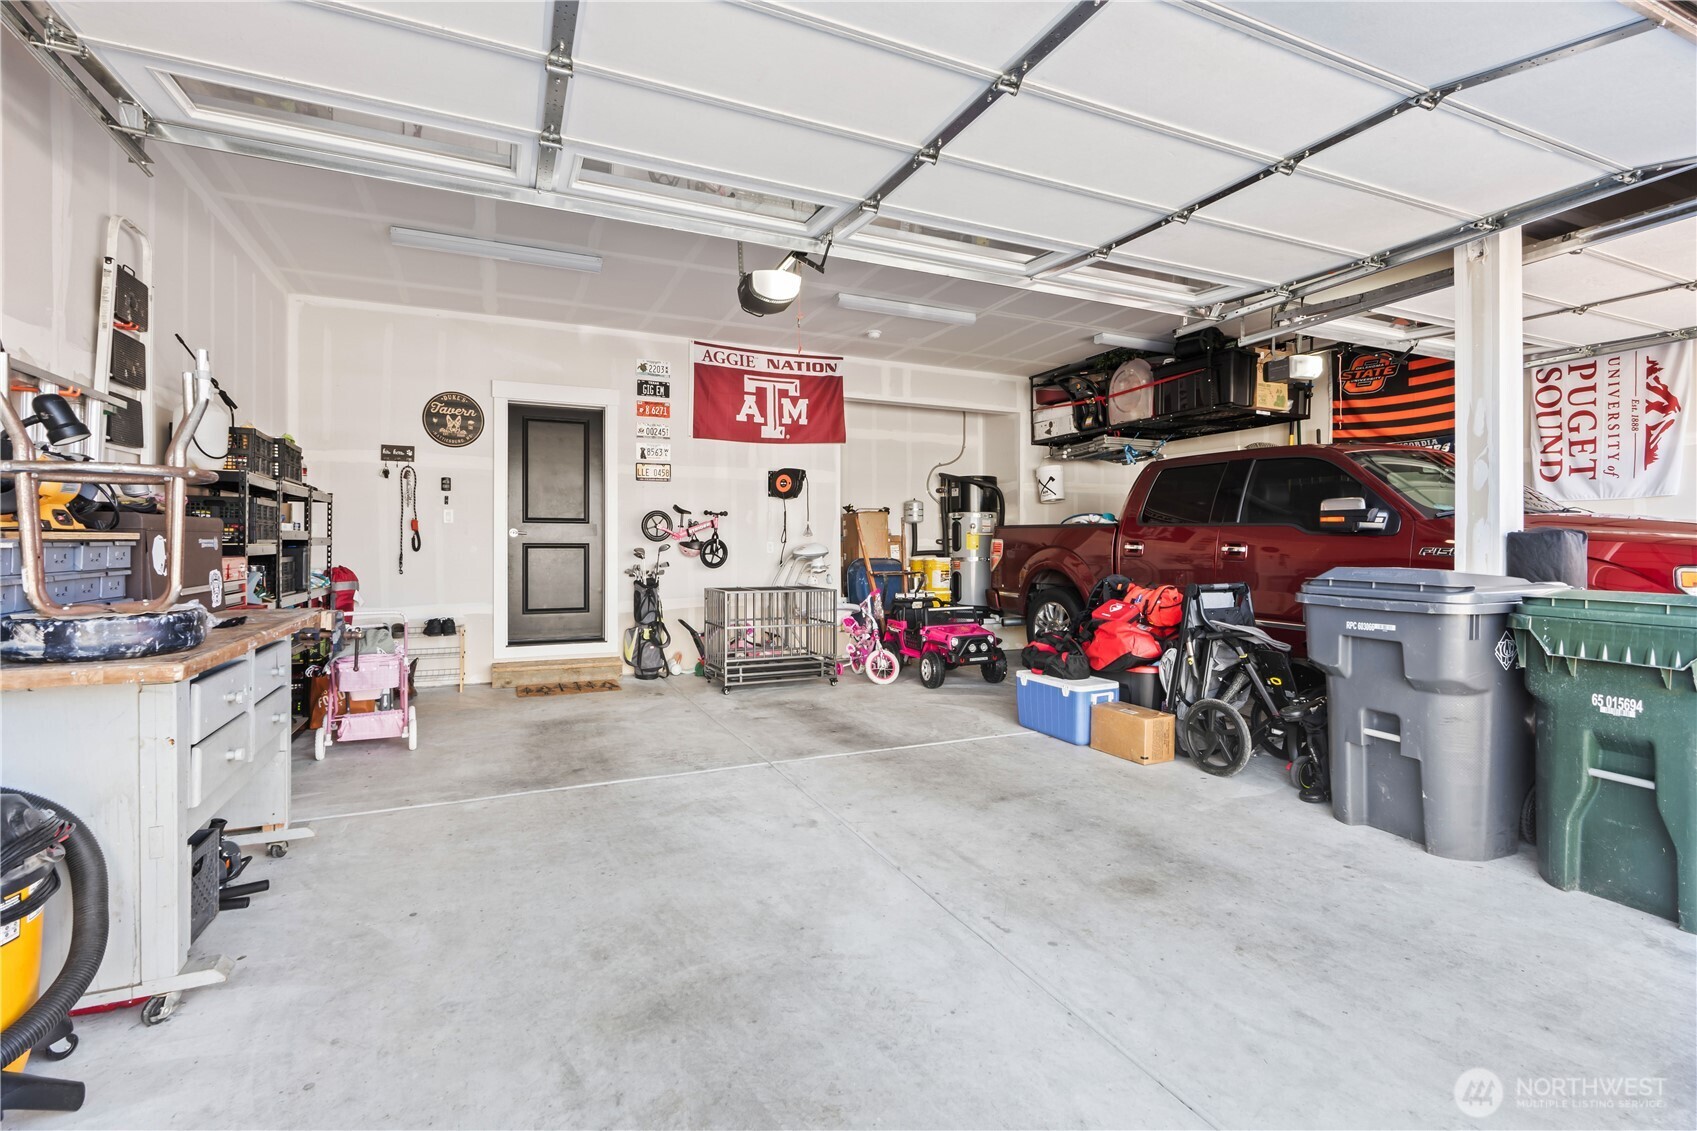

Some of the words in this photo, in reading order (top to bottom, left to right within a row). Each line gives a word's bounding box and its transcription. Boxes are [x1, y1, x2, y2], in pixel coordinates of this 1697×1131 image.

[649, 364, 664, 374] 2203
[702, 350, 755, 368] AGGIE
[767, 358, 837, 373] NATION
[1341, 365, 1396, 380] STATE
[642, 384, 655, 395] GIG
[430, 401, 477, 417] Tavern
[651, 406, 668, 415] 6271
[1607, 356, 1620, 461] UNIVERSITY
[1632, 399, 1640, 412] Est.
[1535, 367, 1563, 483] SOUND
[1567, 360, 1598, 481] PUGET
[1631, 414, 1640, 432] 1888
[646, 447, 663, 457] 8563
[1603, 465, 1620, 479] of
[1345, 620, 1357, 630] RPC
[1591, 692, 1604, 707] 65
[1605, 695, 1643, 713] 015694
